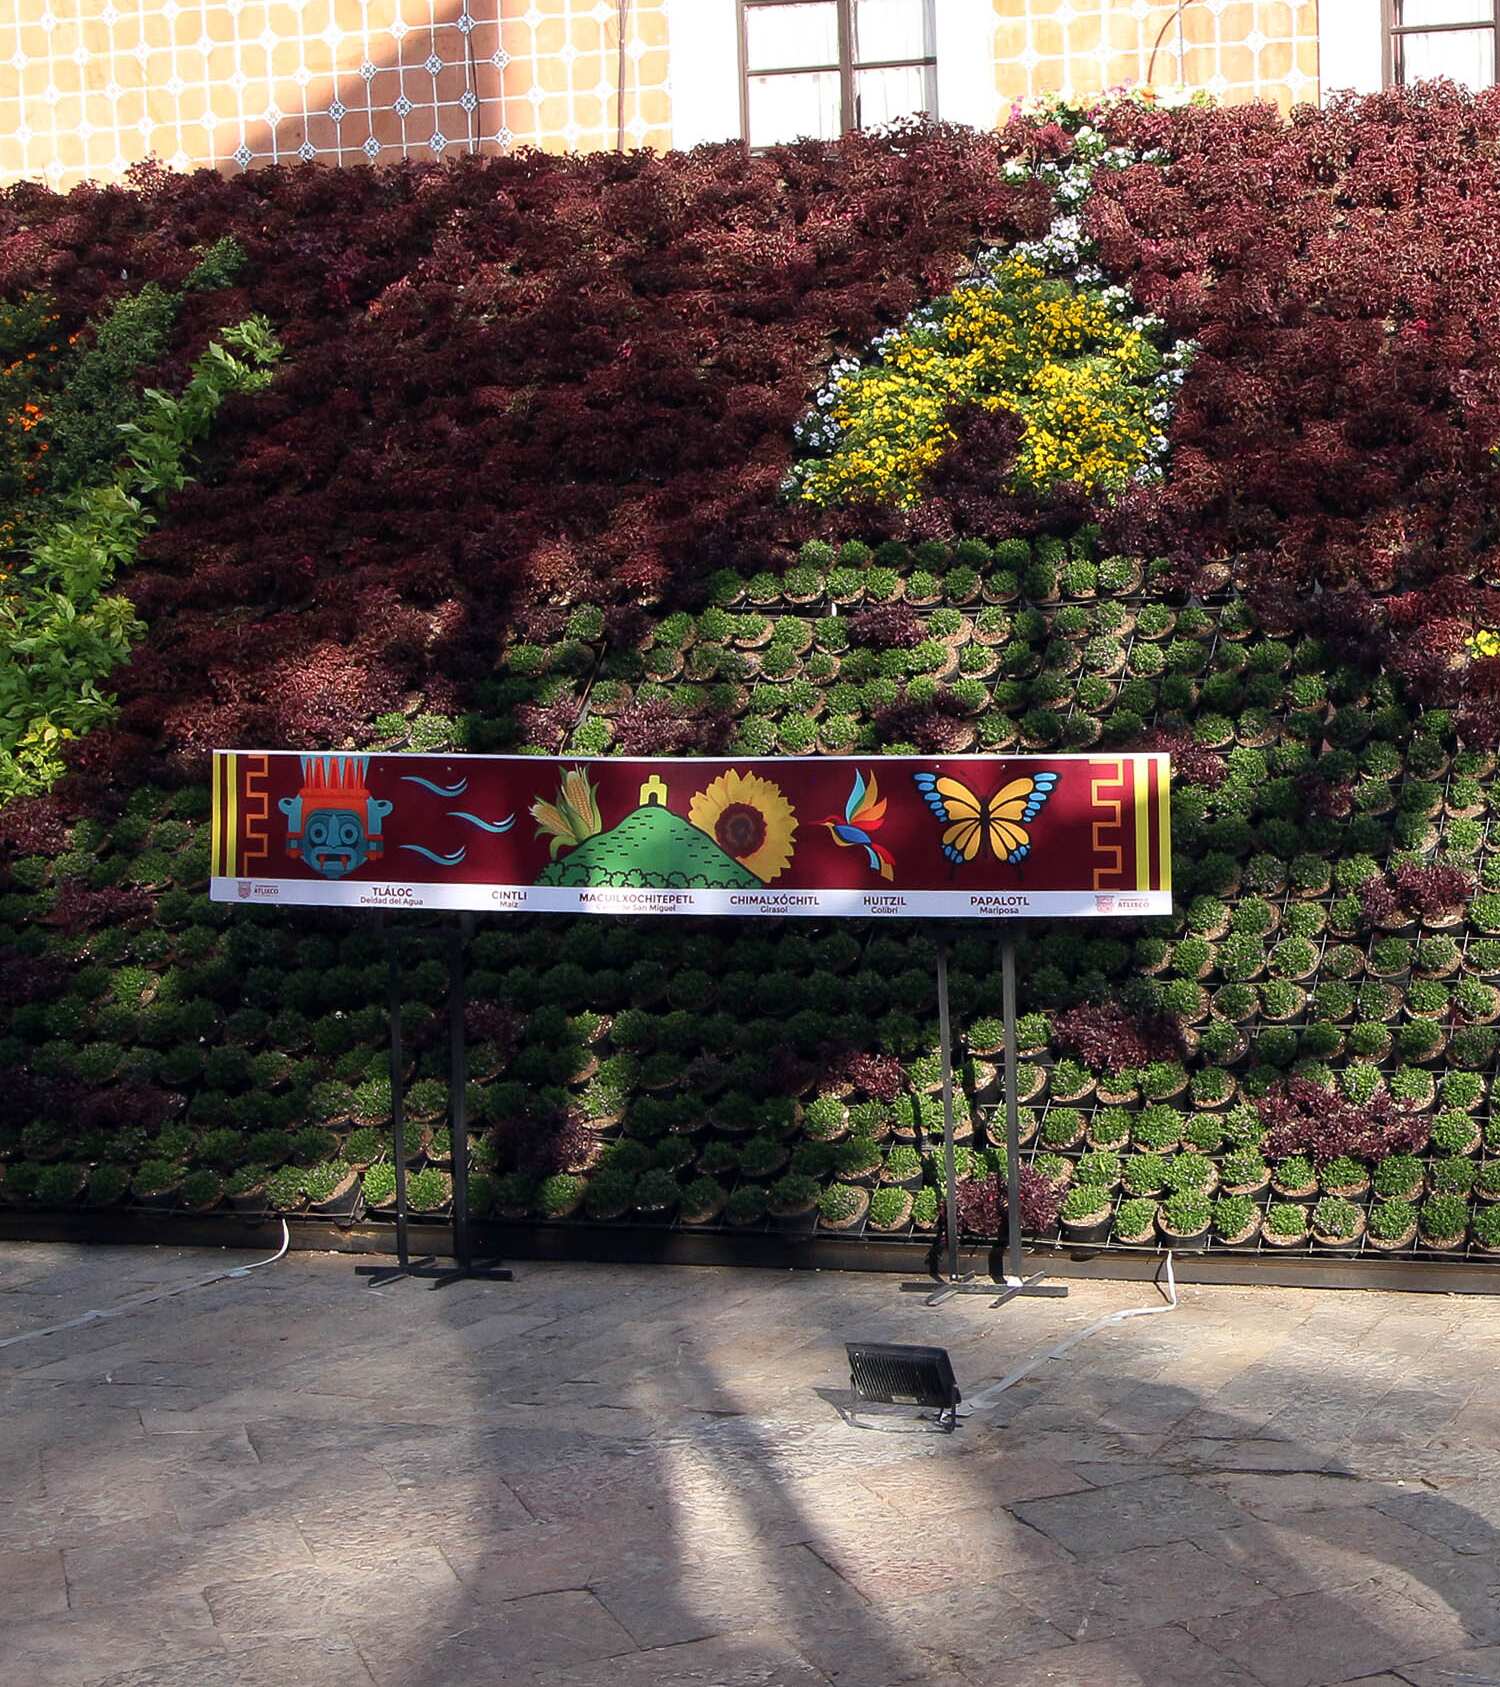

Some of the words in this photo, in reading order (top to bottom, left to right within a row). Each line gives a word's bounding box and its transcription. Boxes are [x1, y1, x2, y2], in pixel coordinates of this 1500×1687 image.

[372, 885, 413, 897] TLÁLOC
[491, 891, 527, 900] CINTLI
[360, 896, 388, 904] Deidad
[389, 897, 401, 905] del
[403, 898, 423, 906] Agua
[579, 893, 695, 904] MACUILXOCHITEPETL
[730, 894, 820, 905] CHIMALXÓCHITL
[863, 896, 907, 906] HUITZIL
[970, 896, 1030, 906] PAPALOTL
[649, 904, 676, 912] Miguel
[760, 905, 788, 913] Girasol
[980, 906, 1019, 915] Mariposa
